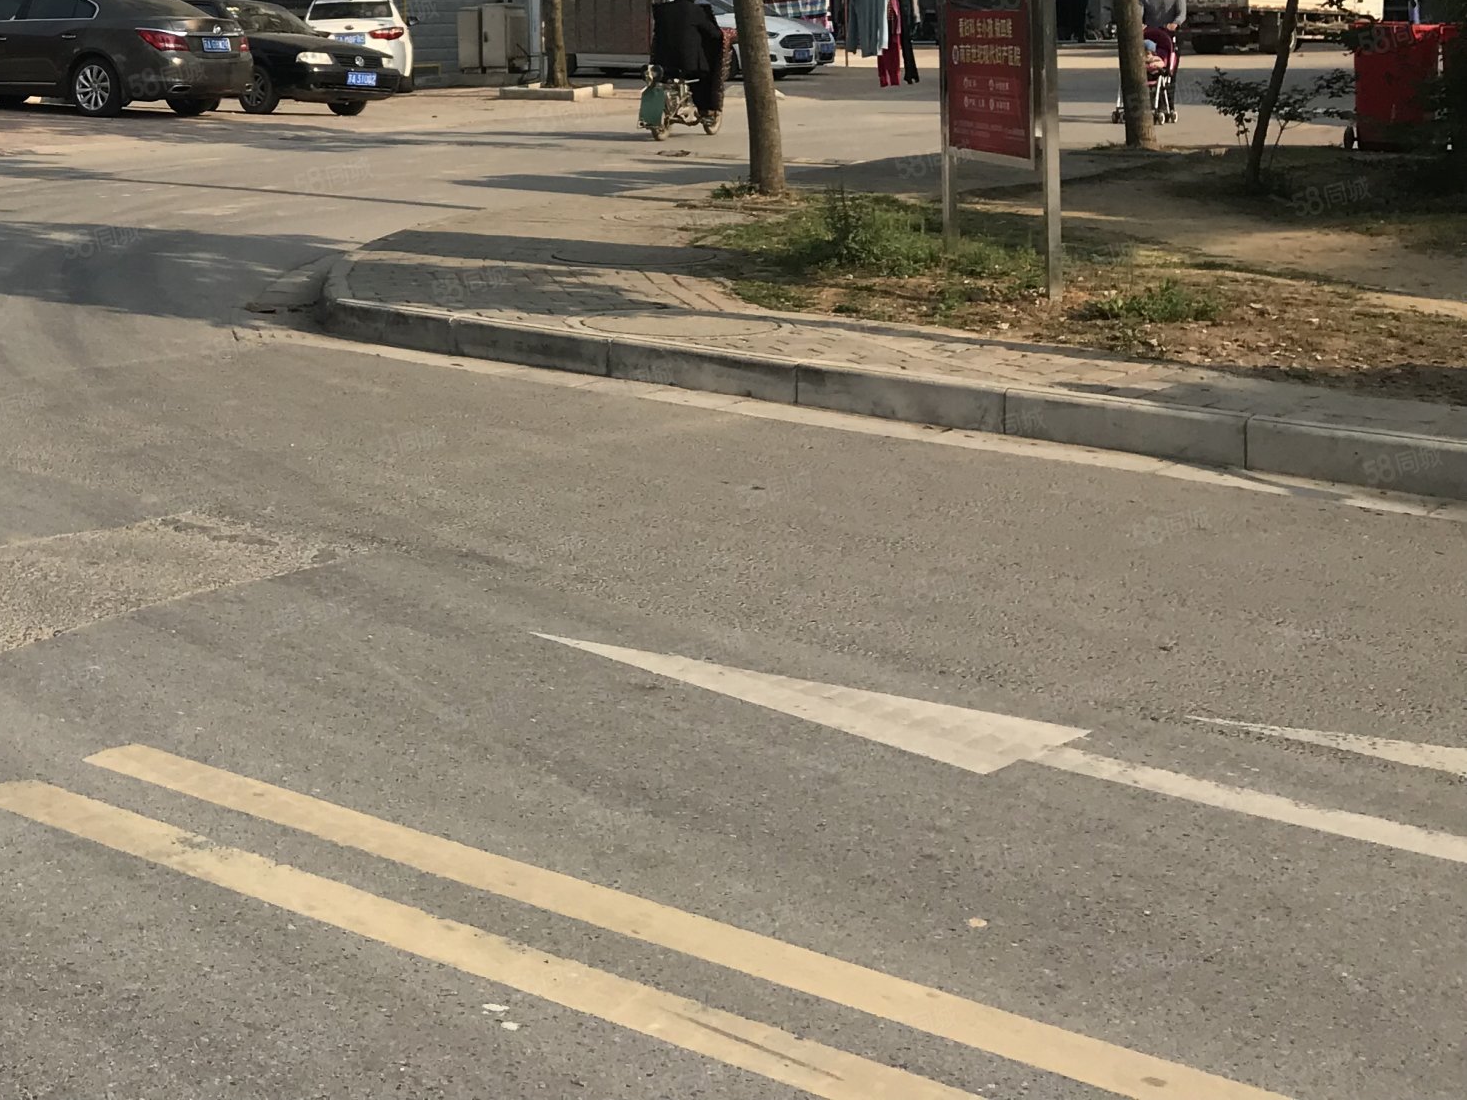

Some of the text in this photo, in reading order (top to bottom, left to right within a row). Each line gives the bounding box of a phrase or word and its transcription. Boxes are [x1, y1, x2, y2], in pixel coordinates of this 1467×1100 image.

[959, 44, 1021, 67] 南京世纪现代妇产医院
